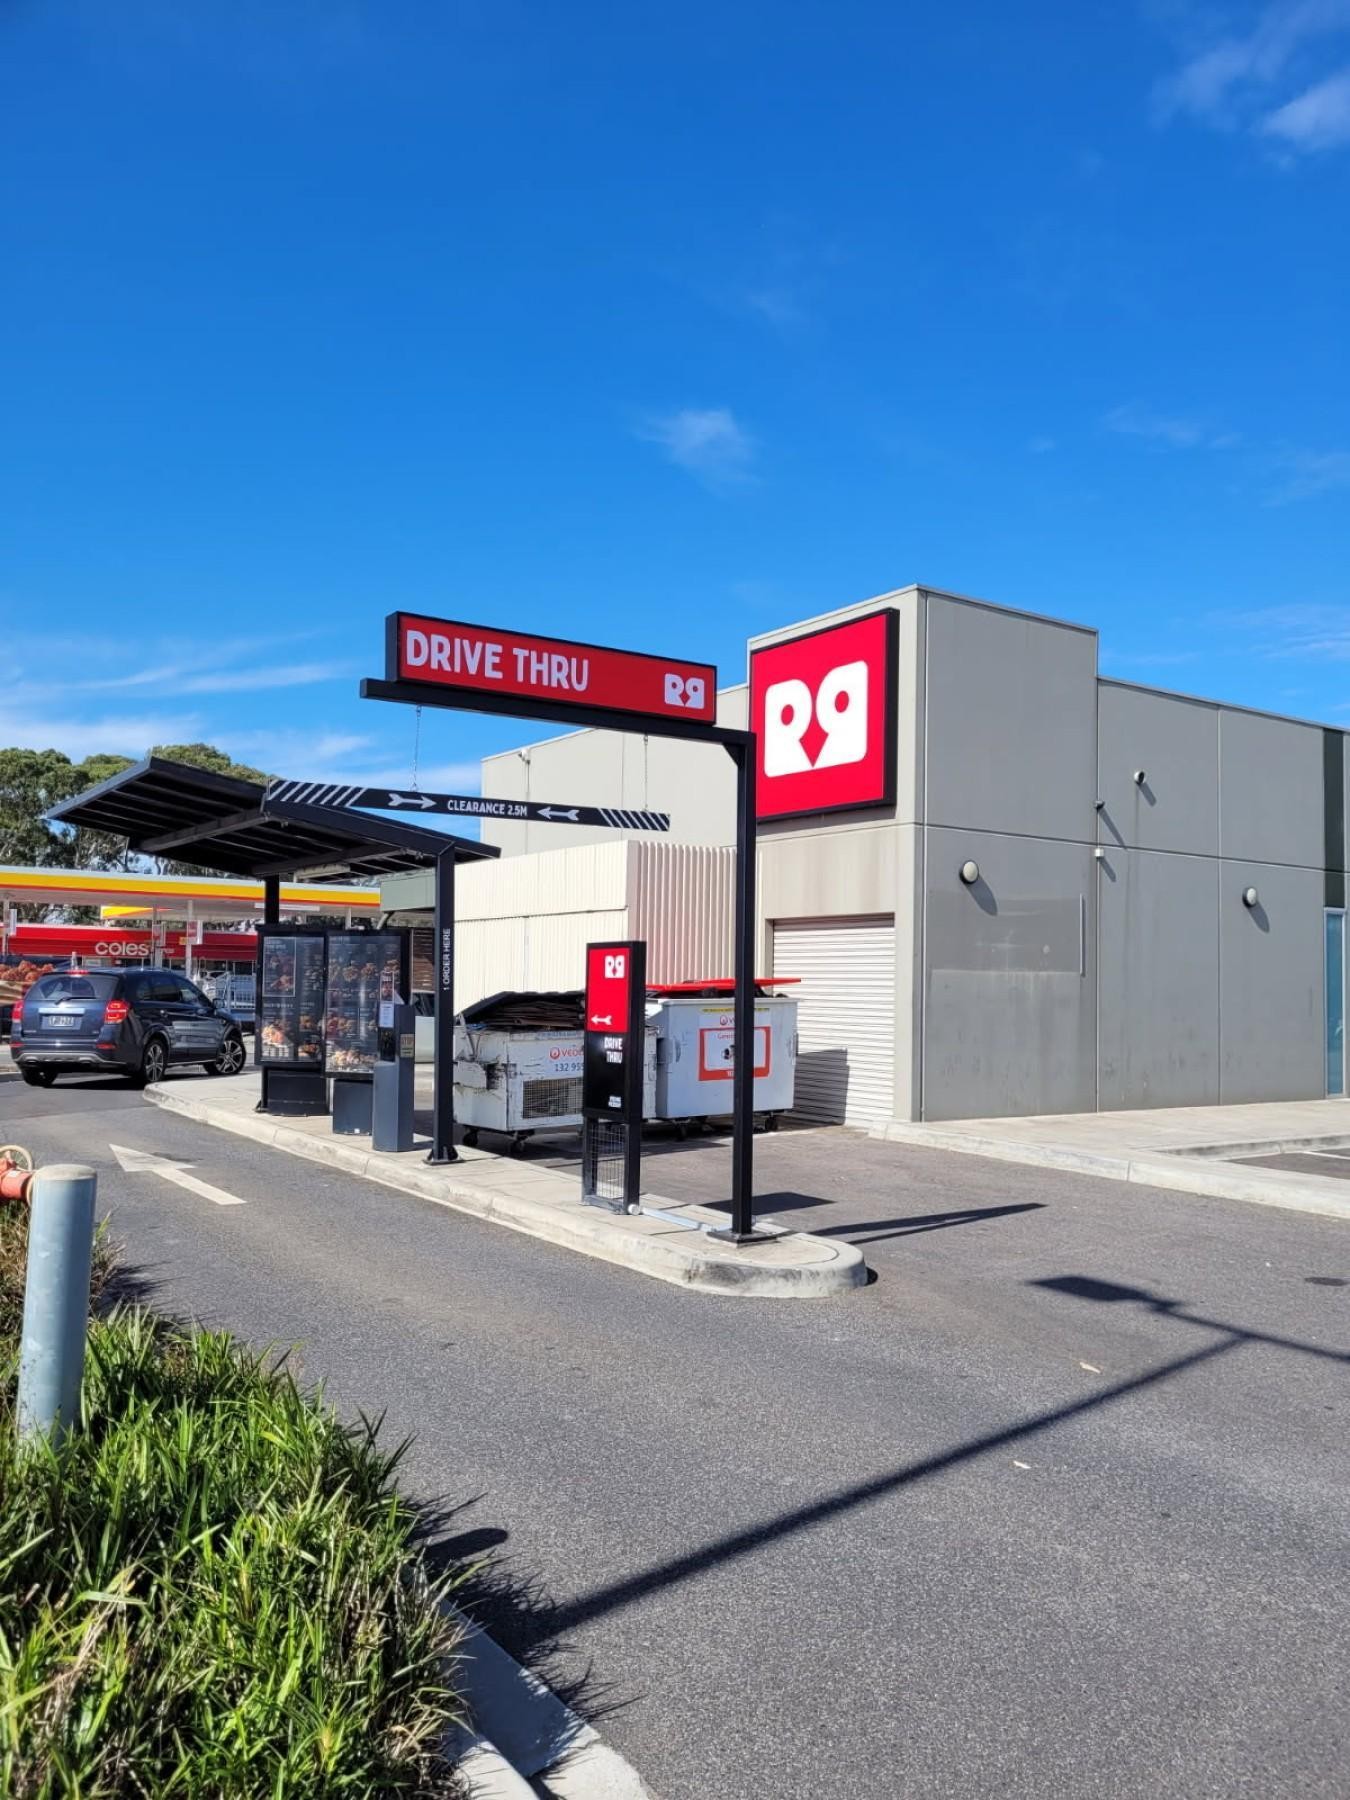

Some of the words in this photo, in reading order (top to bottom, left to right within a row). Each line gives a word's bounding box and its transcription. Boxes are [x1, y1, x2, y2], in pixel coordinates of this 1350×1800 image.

[406, 629, 503, 679] DRIVE
[513, 648, 589, 691] THRU
[447, 800, 505, 814] CLEARANCE
[507, 804, 528, 816] 2.5M
[442, 927, 450, 952] HERE
[95, 941, 149, 956] coles
[442, 953, 450, 985] ORDER
[604, 1036, 623, 1050] DRIVE
[606, 1050, 623, 1064] THRU
[554, 1062, 569, 1072] 132
